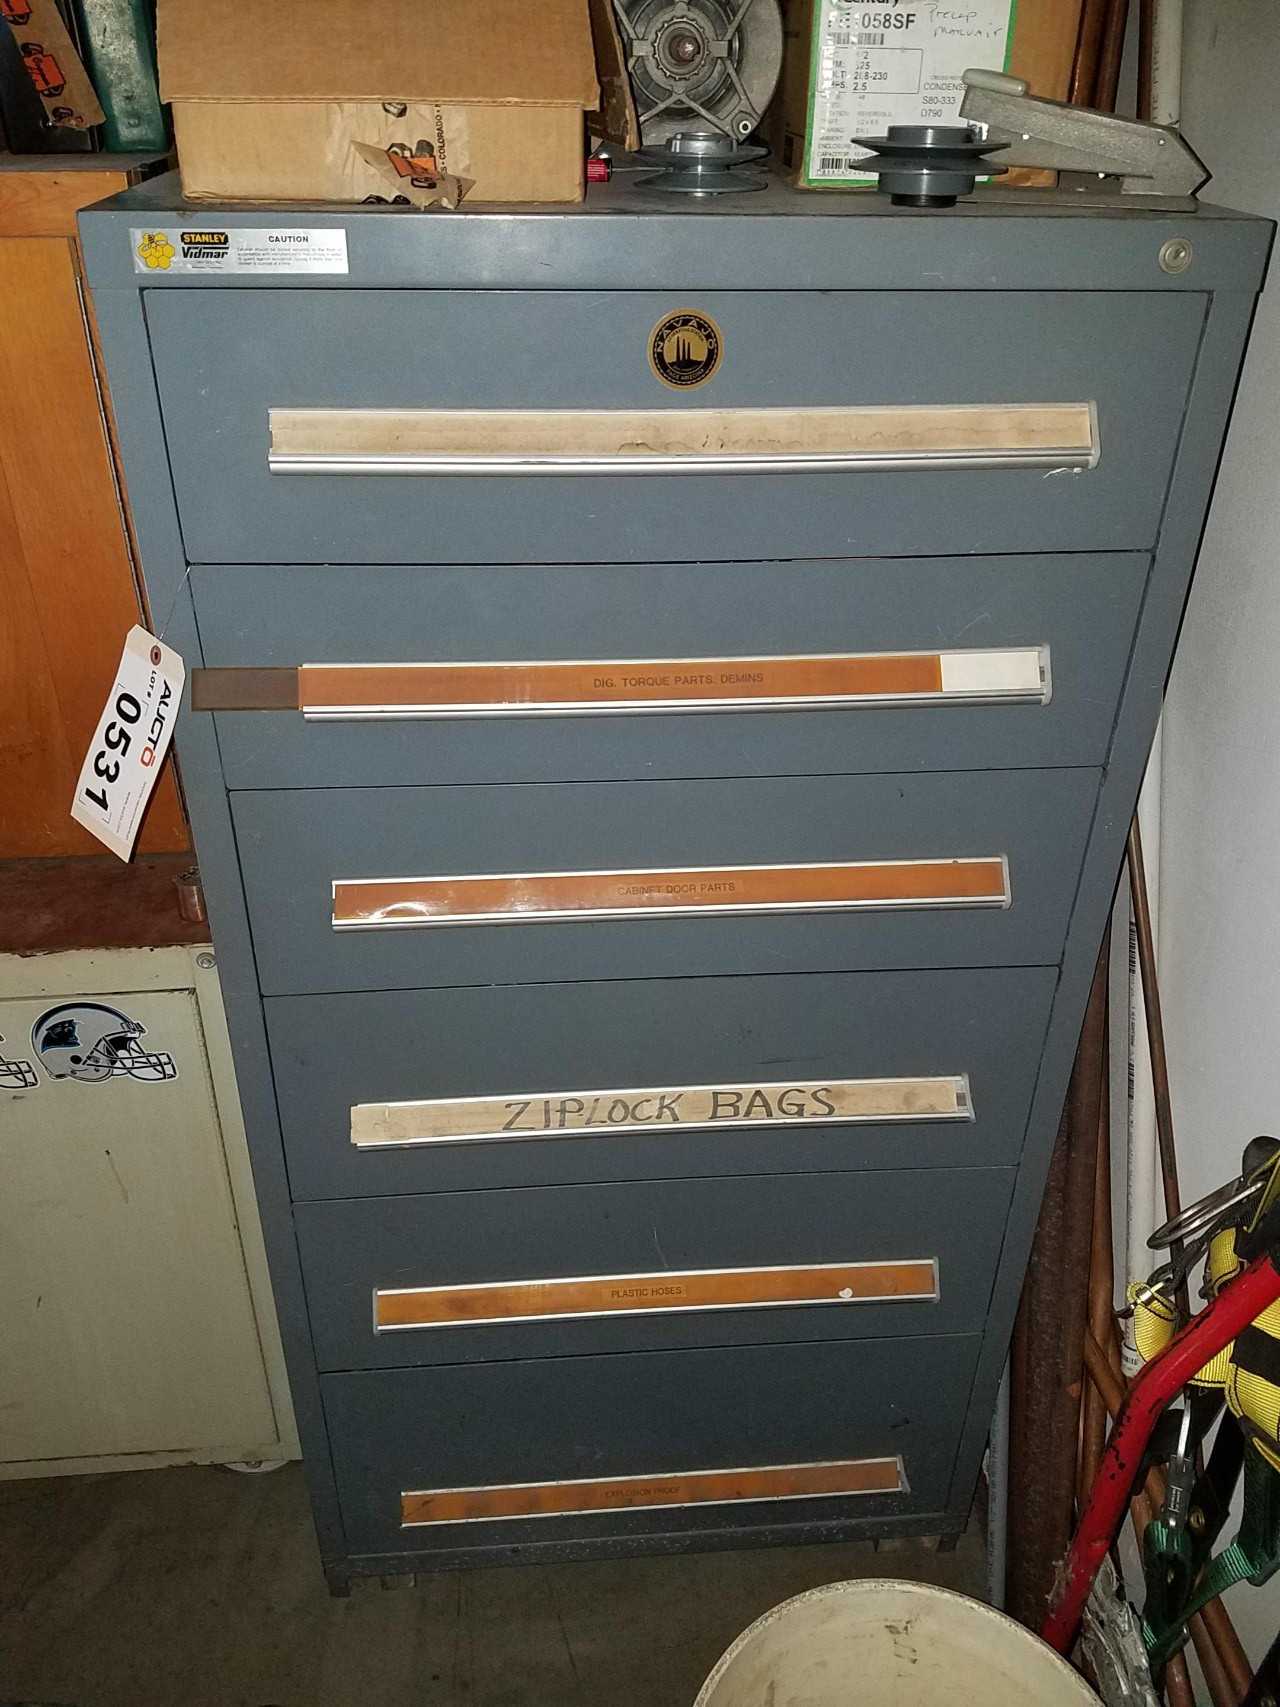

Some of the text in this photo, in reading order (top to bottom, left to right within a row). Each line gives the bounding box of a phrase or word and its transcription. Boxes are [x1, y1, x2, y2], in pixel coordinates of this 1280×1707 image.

[434, 114, 446, 160] COLORADO
[183, 233, 226, 244] STANLEY
[268, 235, 309, 243] CAUTION
[181, 246, 229, 260] Vidmar
[656, 319, 715, 353] NAVAJO
[149, 670, 157, 690] LOT
[593, 677, 617, 689] DIG.
[623, 676, 670, 688] TORQUE
[720, 672, 764, 684] DEMINS
[85, 691, 141, 813] 0531
[617, 881, 736, 896] CABINET DOOR PARTS
[502, 1086, 837, 1132] ZIPLOCK BAGS
[611, 1286, 682, 1298] PLASTIC HOSES
